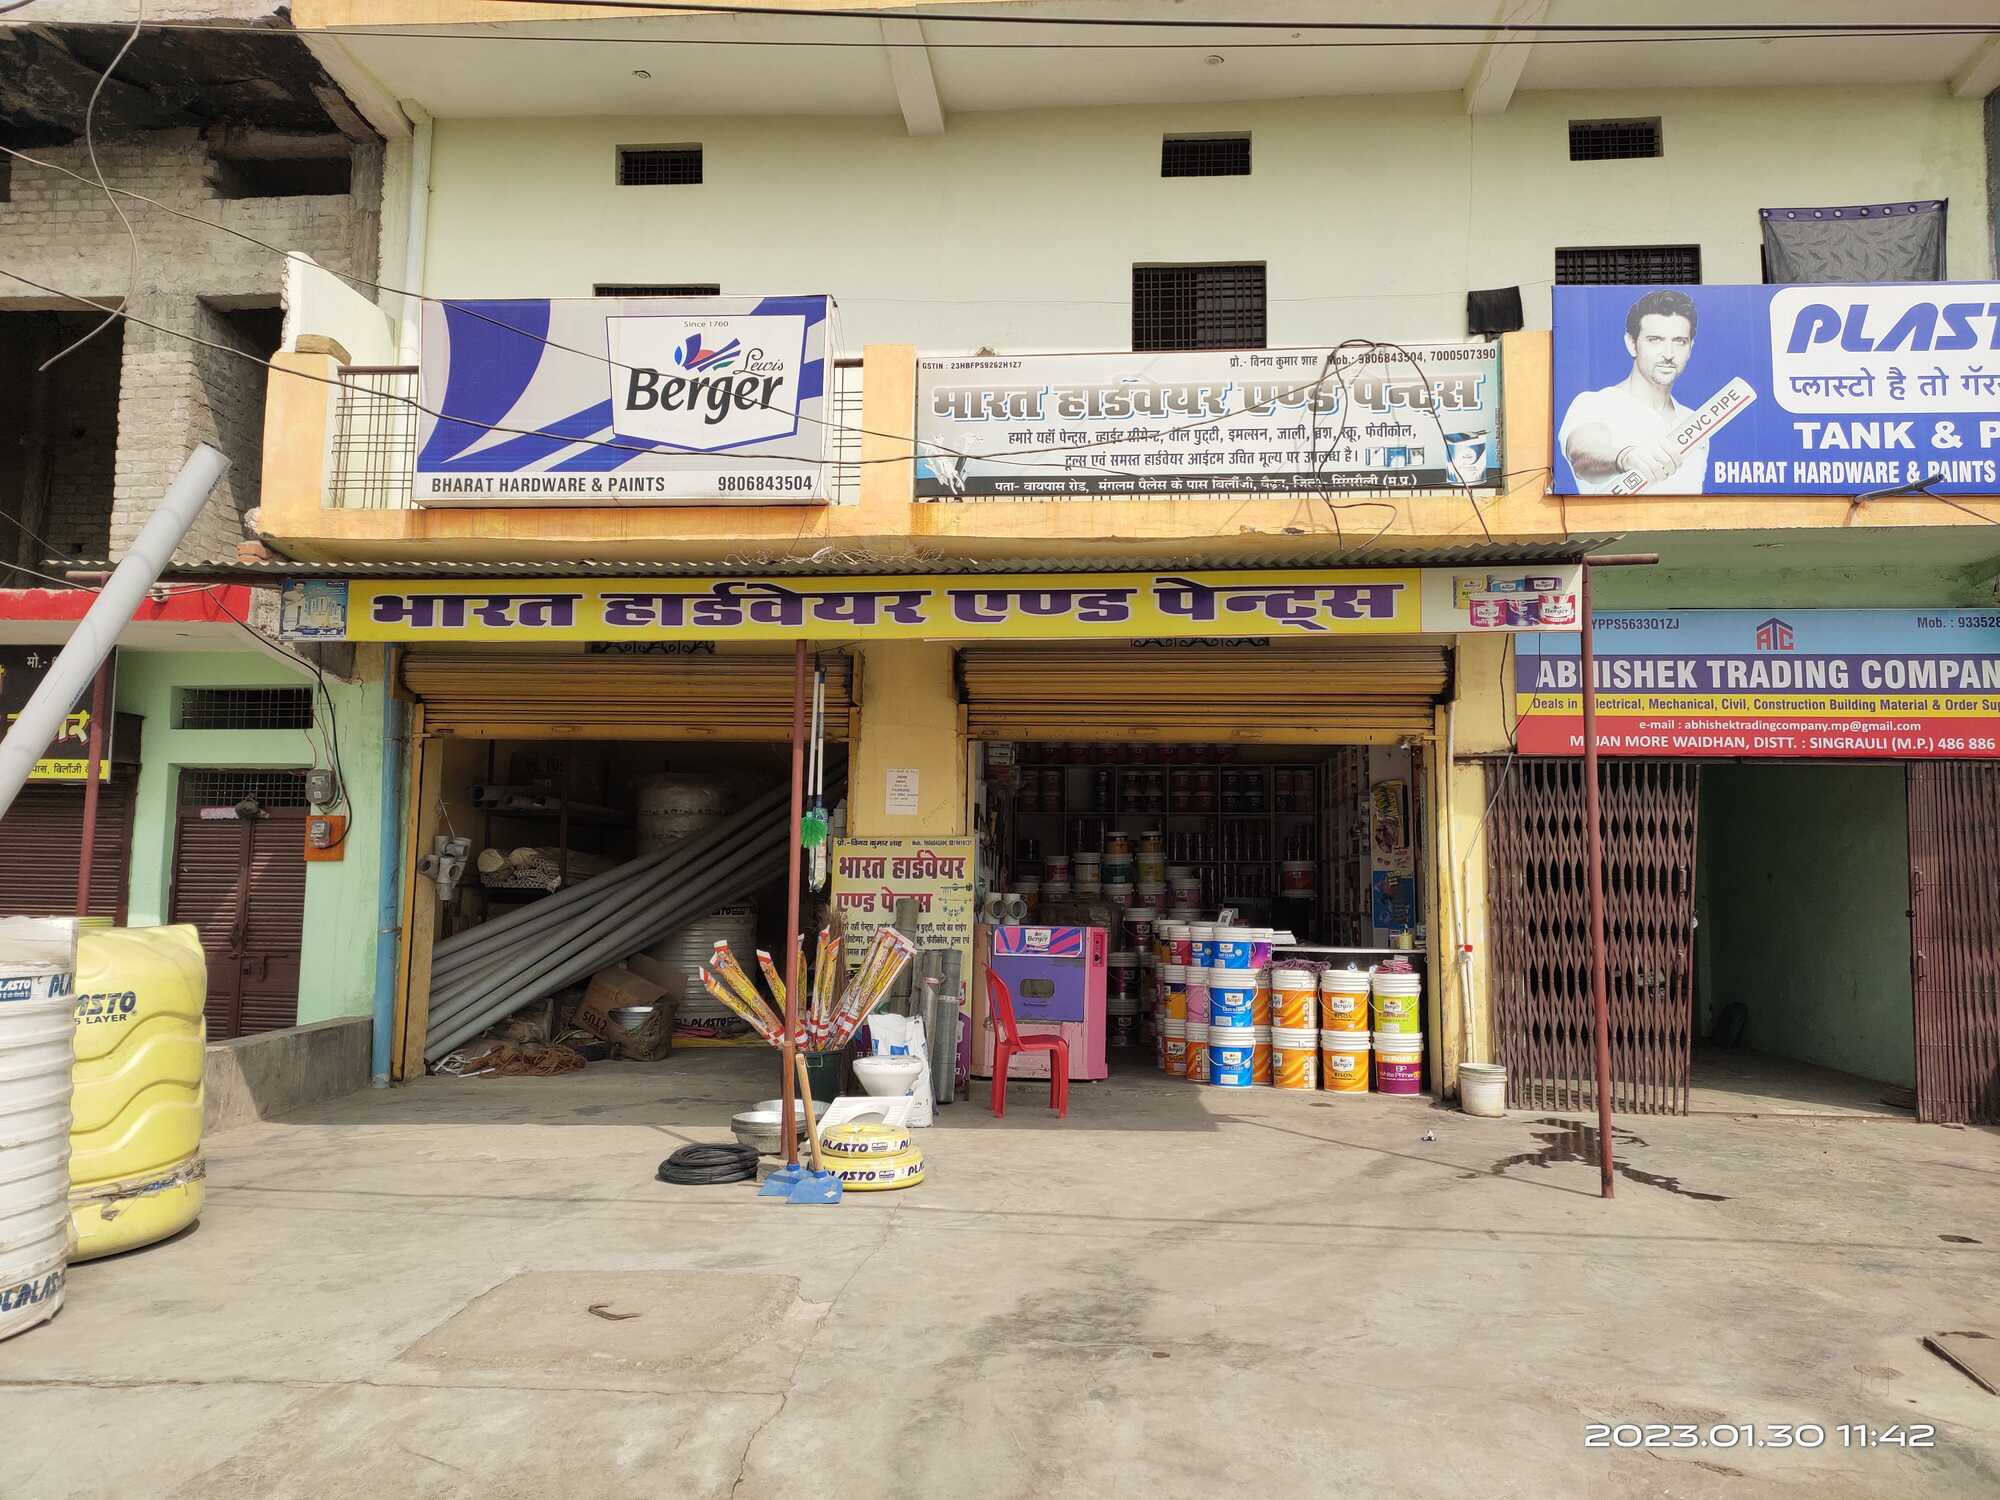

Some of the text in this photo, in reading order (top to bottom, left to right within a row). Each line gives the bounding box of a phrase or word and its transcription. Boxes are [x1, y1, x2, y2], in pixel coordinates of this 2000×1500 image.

[683, 320, 730, 328] Since 1760
[732, 347, 785, 377] Lewis
[1275, 355, 1299, 370] कुमार
[1301, 355, 1318, 366] शाह
[1430, 348, 1497, 362] 7000507390
[922, 362, 944, 370] GSTIN
[1789, 366, 1875, 398] प्लास्टो
[1886, 366, 1907, 400] है
[1918, 366, 1950, 397] तो
[625, 367, 784, 425] Berger
[932, 384, 1048, 421] भारत
[1237, 377, 1344, 417] एण्ड
[1677, 389, 1741, 446] CPVC PIPE
[1007, 427, 1033, 445] हमारे
[1227, 427, 1273, 443] इमल्सन,
[1276, 424, 1310, 442] जाली,
[1365, 422, 1417, 440] फेवीकोल,
[1793, 422, 1916, 449] TANK
[1930, 420, 1963, 449] &
[1091, 450, 1107, 467] एवं
[1111, 453, 1141, 467] समस्त
[1187, 449, 1224, 466] आईटम
[1228, 448, 1255, 465] उचित
[1259, 449, 1282, 468] मूल्य
[1287, 450, 1299, 464] पर
[1713, 460, 1996, 483] BHARAT HARDWARE & PAINTS
[431, 476, 666, 493] BHARAT HARDWARE & PAINTS
[717, 475, 813, 492] 9806843504
[1069, 477, 1090, 493] रोड,
[1169, 475, 1183, 489] के
[1186, 477, 1209, 490] पास
[374, 593, 584, 628] भारत
[600, 581, 932, 626] हार्डवेयर
[946, 589, 1138, 623] एण्ड
[1592, 618, 1679, 630] YPPS5633Q1ZJ
[1706, 659, 1849, 689] TRADING
[1533, 697, 1564, 710] Deals
[1567, 698, 1578, 709] in
[1594, 698, 1645, 712] lectrical,
[1648, 698, 1718, 712] Mechanical,
[1721, 698, 1750, 712] Civil,
[1753, 698, 1826, 711] Construction
[1829, 698, 1876, 713] Building
[1880, 698, 1928, 711] Material
[1932, 699, 1941, 711] &
[1945, 699, 1978, 711] Order
[1639, 719, 1675, 730] e-mail
[1684, 719, 1921, 733] abhishektradingcompany.mp@gmail.com
[1570, 735, 1621, 748] MJAN
[1625, 735, 1669, 748] MORE
[1673, 735, 1750, 750] WAIDHAN,
[1753, 737, 1797, 749] DISTT.
[1809, 737, 1887, 750] SINGRAULI
[1891, 736, 1934, 752] (M.P.)
[1937, 737, 1965, 750] 486
[1968, 737, 1996, 750] 886
[839, 850, 966, 880] भारत हार्डवेयर
[836, 886, 934, 913] एण्ड पेस
[77, 991, 137, 1016] ASTO
[86, 1013, 127, 1024] LAYER
[822, 1138, 869, 1153] PLASTO
[828, 1169, 876, 1181] ASTO
